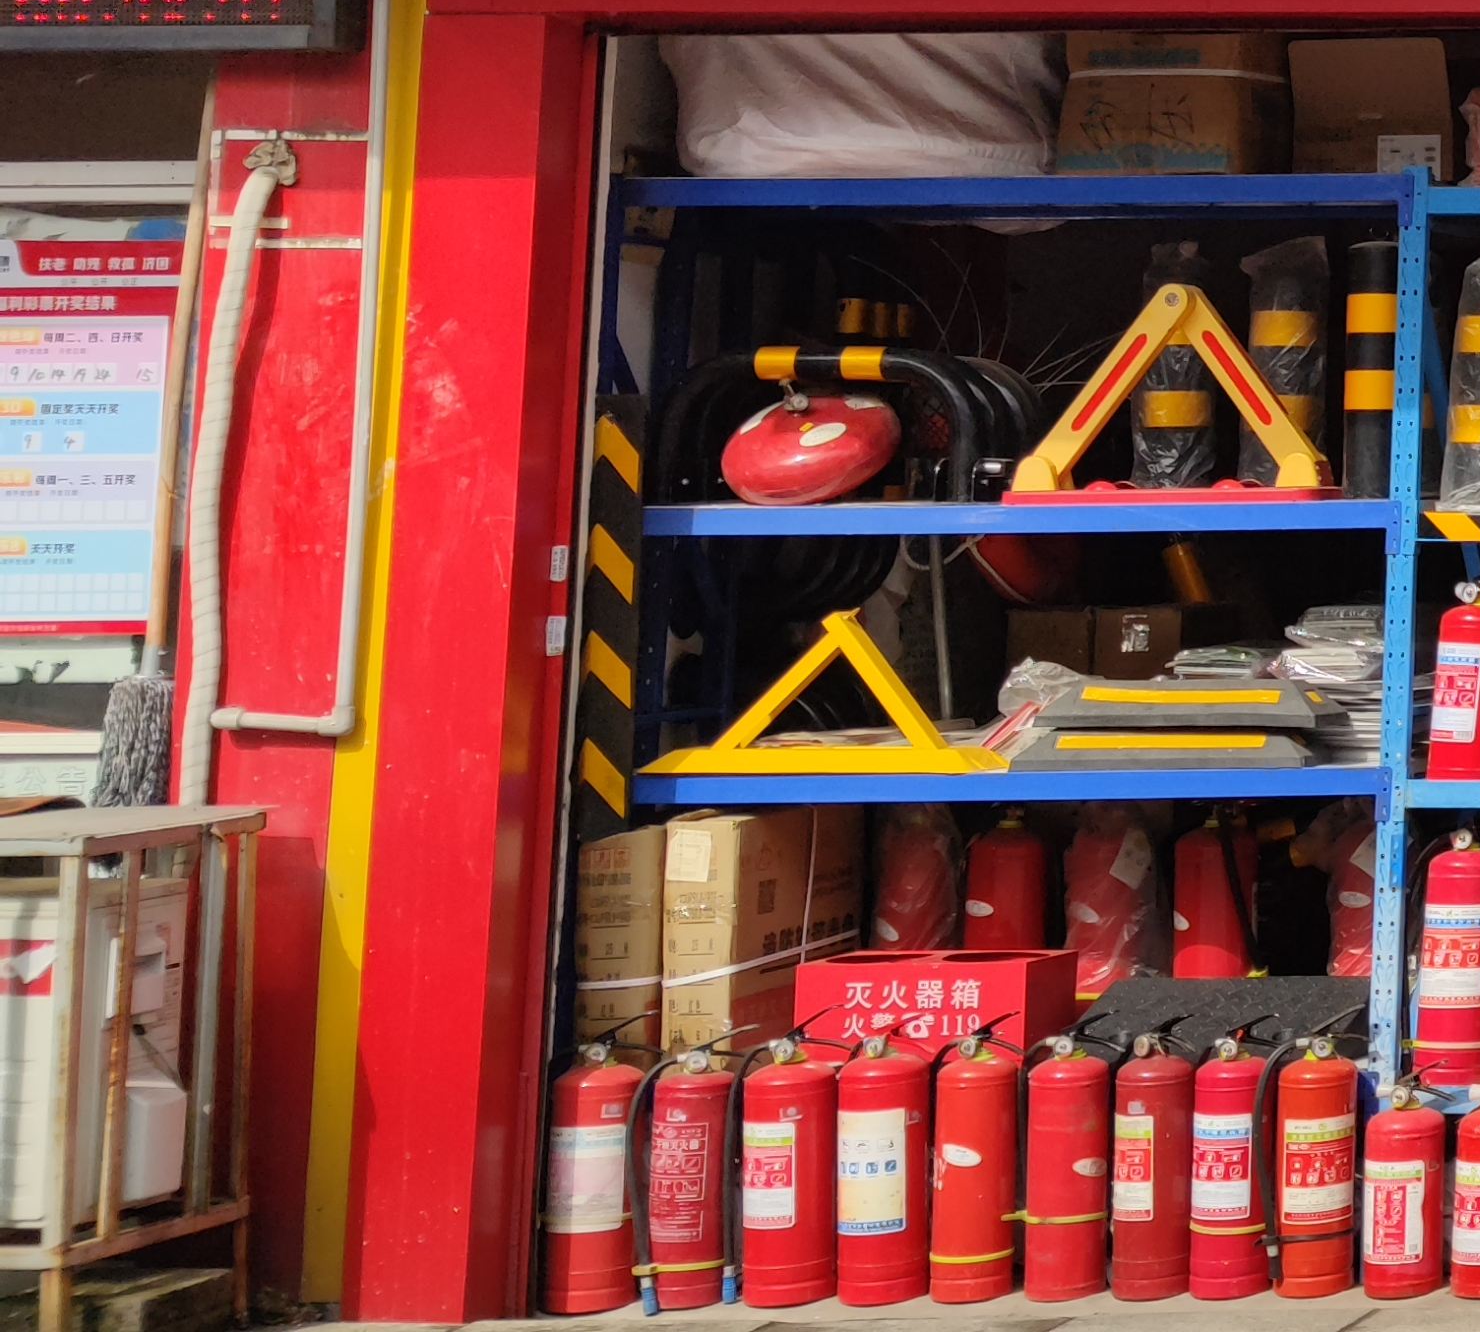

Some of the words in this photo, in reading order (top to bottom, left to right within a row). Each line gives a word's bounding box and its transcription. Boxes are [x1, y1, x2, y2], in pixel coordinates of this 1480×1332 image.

[0, 765, 88, 798] 公告
[843, 979, 982, 1010] 灭火器箱
[939, 1013, 981, 1036] 119
